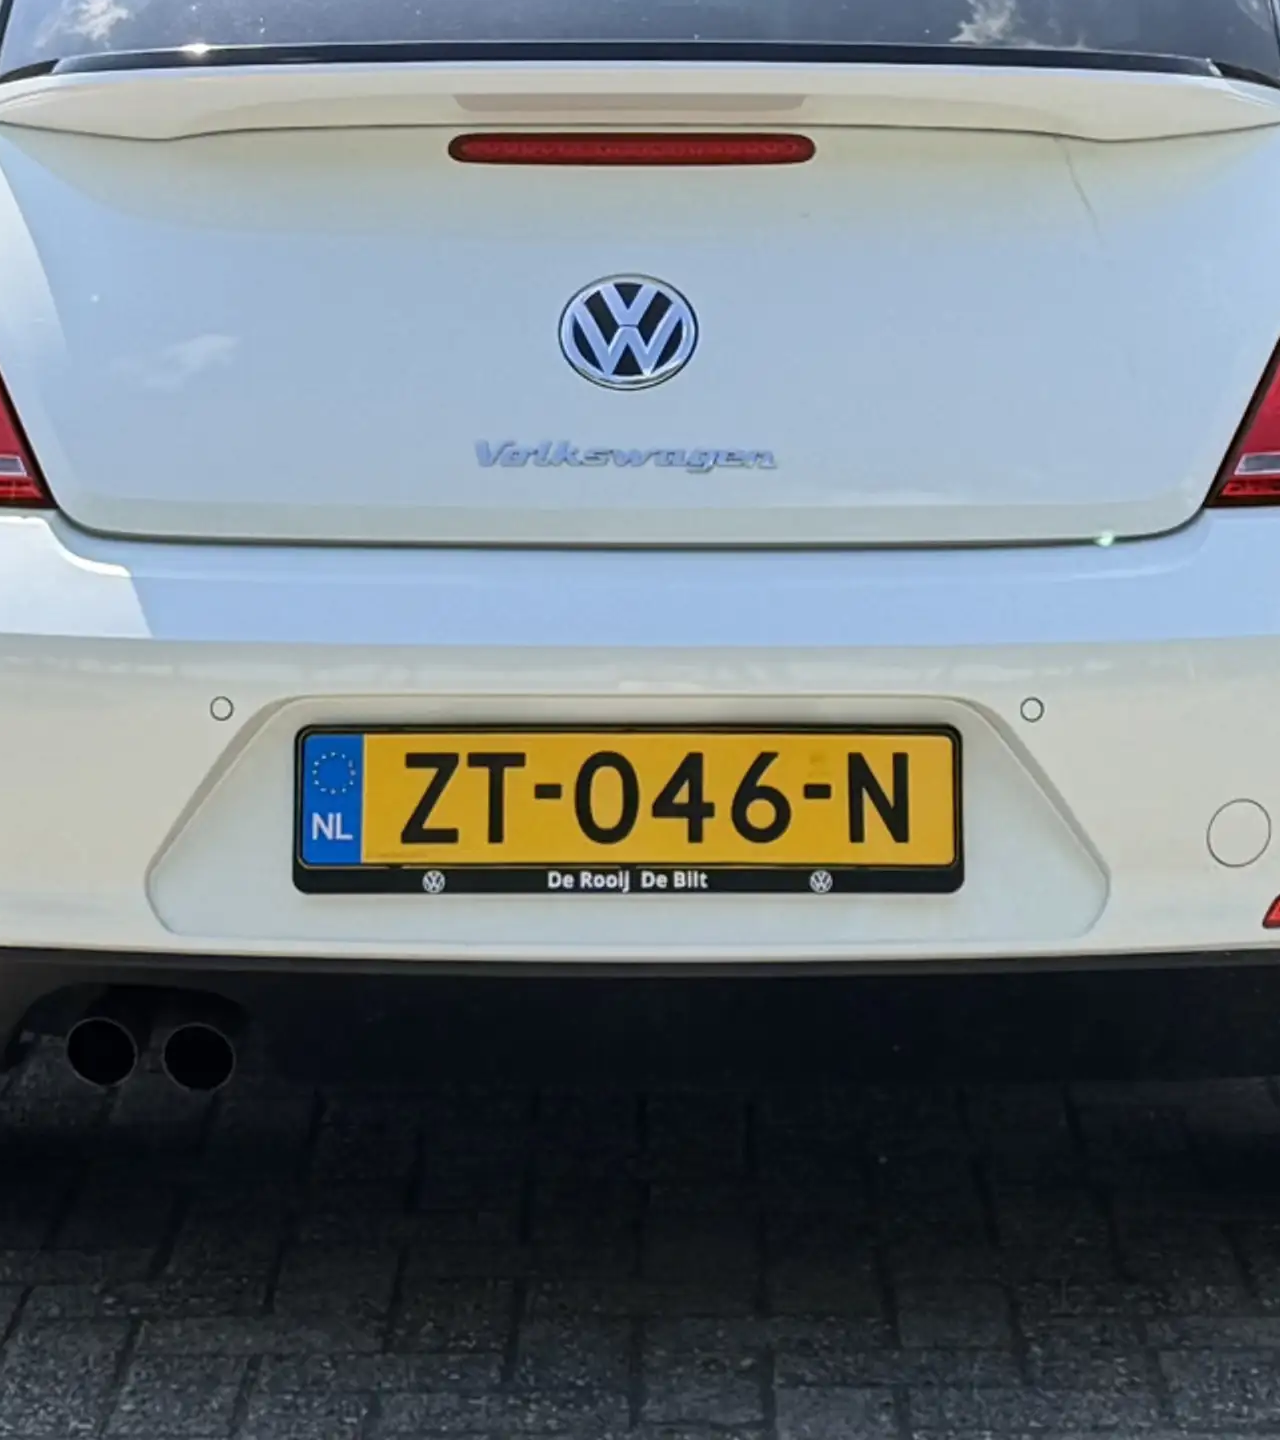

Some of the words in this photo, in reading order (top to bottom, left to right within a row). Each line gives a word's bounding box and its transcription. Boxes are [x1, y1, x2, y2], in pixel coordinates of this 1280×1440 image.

[474, 439, 778, 474] Volkswagen
[400, 750, 911, 845] ZT-046-N
[311, 812, 353, 841] NL
[547, 870, 574, 889] De
[580, 870, 630, 893] Rooij
[640, 870, 667, 889] De
[673, 870, 709, 889] Bilt
